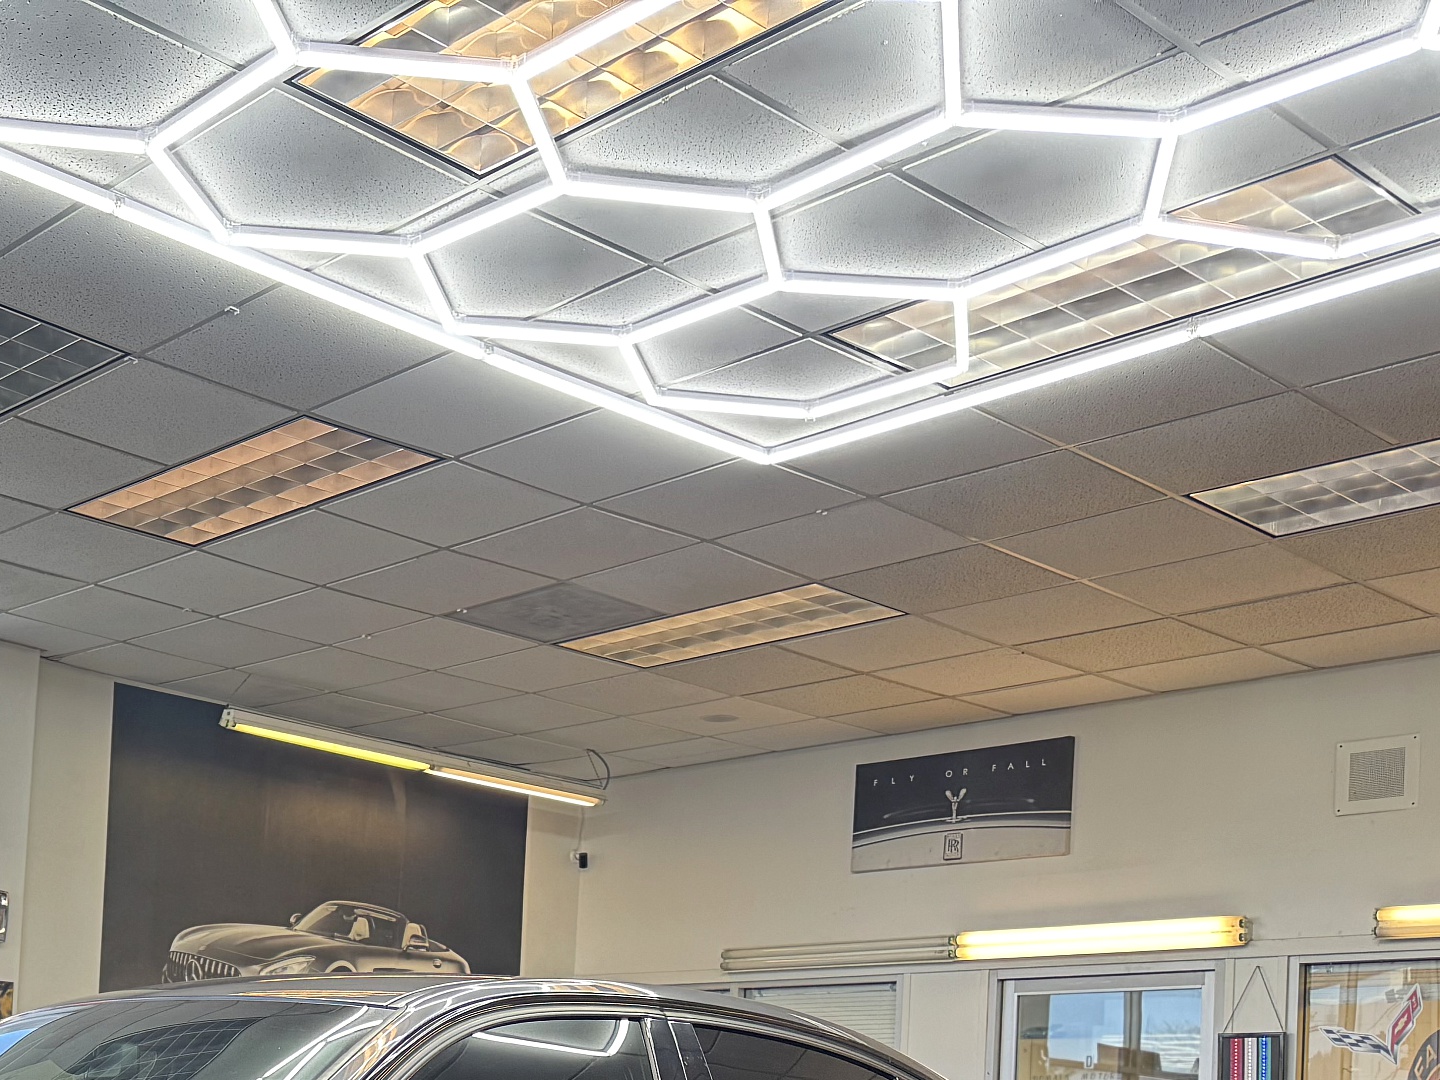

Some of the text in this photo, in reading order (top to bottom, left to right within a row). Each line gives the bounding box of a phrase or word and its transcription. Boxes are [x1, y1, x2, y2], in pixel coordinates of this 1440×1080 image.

[873, 758, 1046, 787] FLY OR FALL
